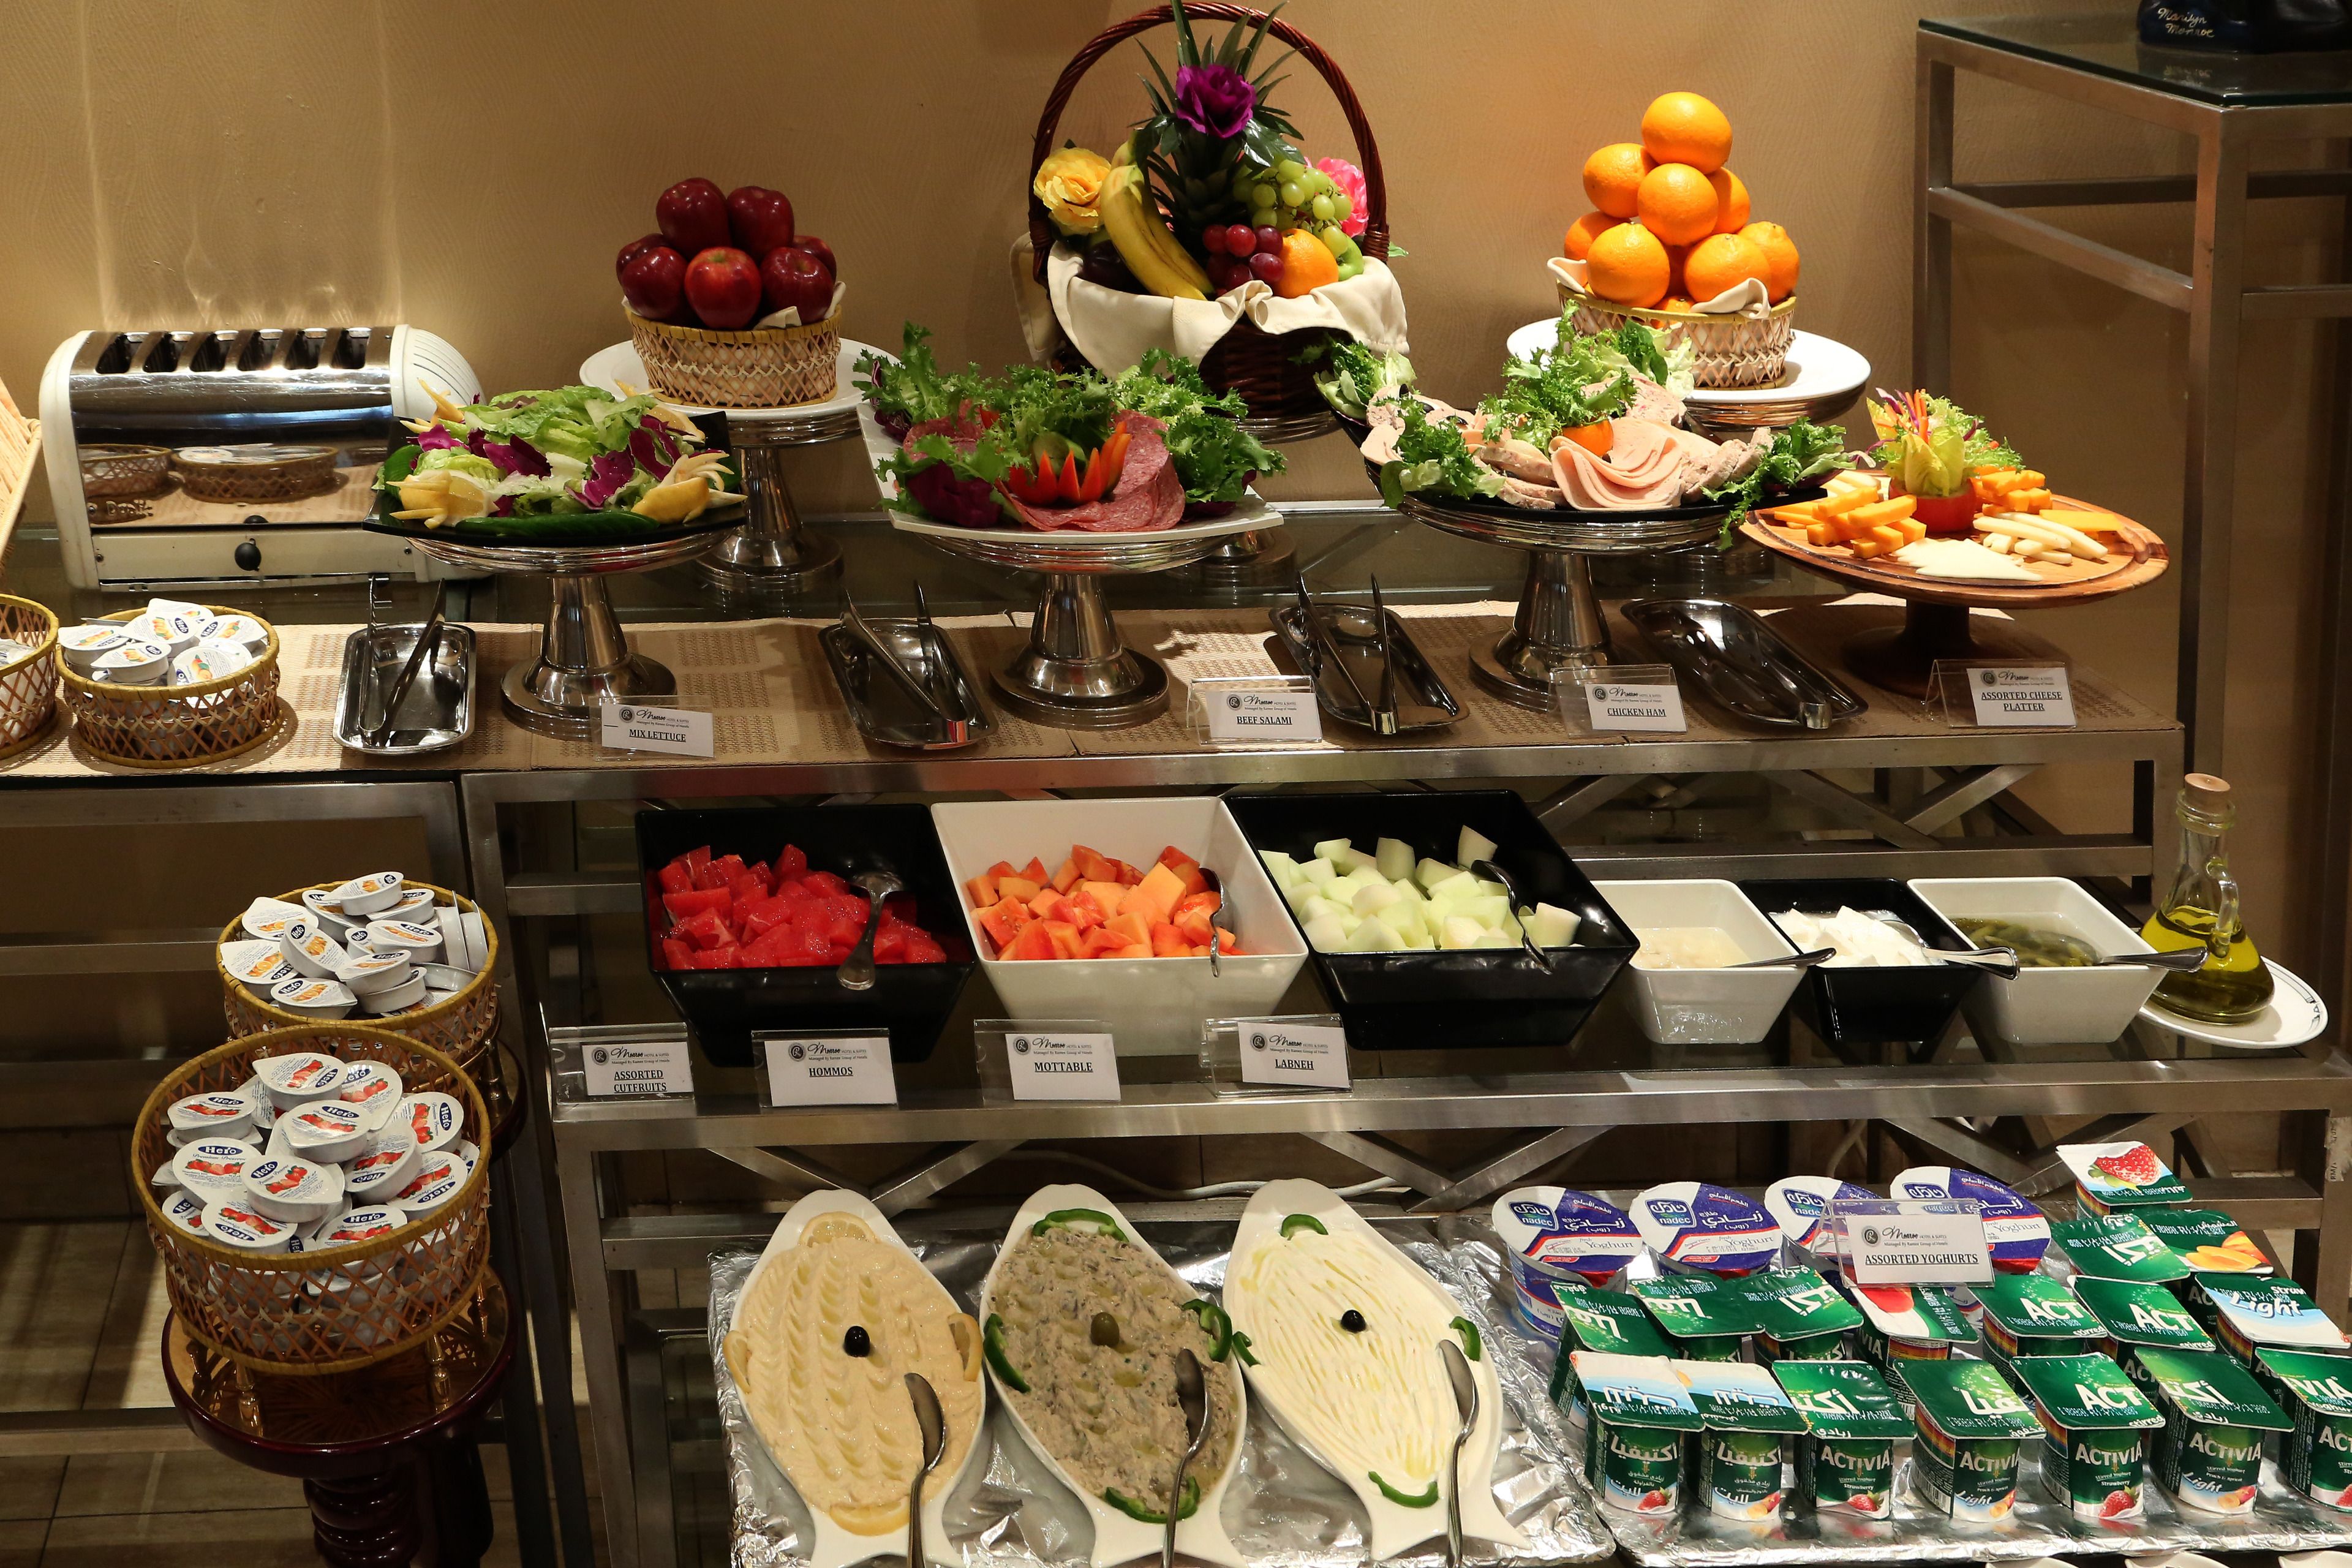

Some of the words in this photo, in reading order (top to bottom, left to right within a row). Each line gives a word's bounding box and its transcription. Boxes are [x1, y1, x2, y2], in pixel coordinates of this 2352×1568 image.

[2157, 7, 2207, 28] Marilyn
[175, 619, 188, 633] Hero
[203, 623, 217, 636] Hero
[629, 729, 646, 737] MIX
[648, 731, 686, 741] LETTUCE
[292, 926, 304, 939] Hero
[405, 925, 429, 935] Hero
[352, 932, 366, 941] Hero
[281, 982, 301, 993] Hero
[1035, 1062, 1093, 1071] MOTTABLE
[1275, 1059, 1313, 1069] LABNEH
[614, 1070, 663, 1079] ASSORTED
[809, 1067, 853, 1076] HOMMOS
[317, 1071, 337, 1086] Hero
[614, 1082, 666, 1092] CUTFRUITS
[326, 1107, 354, 1118] Hero
[441, 1107, 450, 1128] Hero
[252, 1163, 275, 1178] Hero
[356, 1173, 382, 1183] Hero
[423, 1185, 451, 1201] Hero
[350, 1213, 380, 1223] Hero
[1521, 1217, 1553, 1227] nadec
[221, 1226, 249, 1240] Hero
[1992, 1223, 2041, 1234] Yoghurt
[1585, 1240, 1634, 1250] Yoghurt
[1725, 1236, 1774, 1248] Yoghurt
[1866, 1254, 1918, 1264] ASSORTED
[1923, 1254, 1978, 1263] YOGHURTS
[2020, 1298, 2084, 1320] ACT
[2230, 1291, 2303, 1318] Light
[2129, 1304, 2194, 1331] ACT
[2073, 1326, 2105, 1336] stirred
[2075, 1384, 2143, 1411] ACT
[2129, 1415, 2165, 1427] stirred
[2189, 1431, 2261, 1461] ACTIVIA
[1821, 1445, 1890, 1471] ACTIVIA
[1960, 1447, 2019, 1472] ACTIVIA
[2076, 1441, 2142, 1466] ACTIVIA
[2184, 1472, 2223, 1493] Light
[1955, 1490, 1992, 1506] Light
